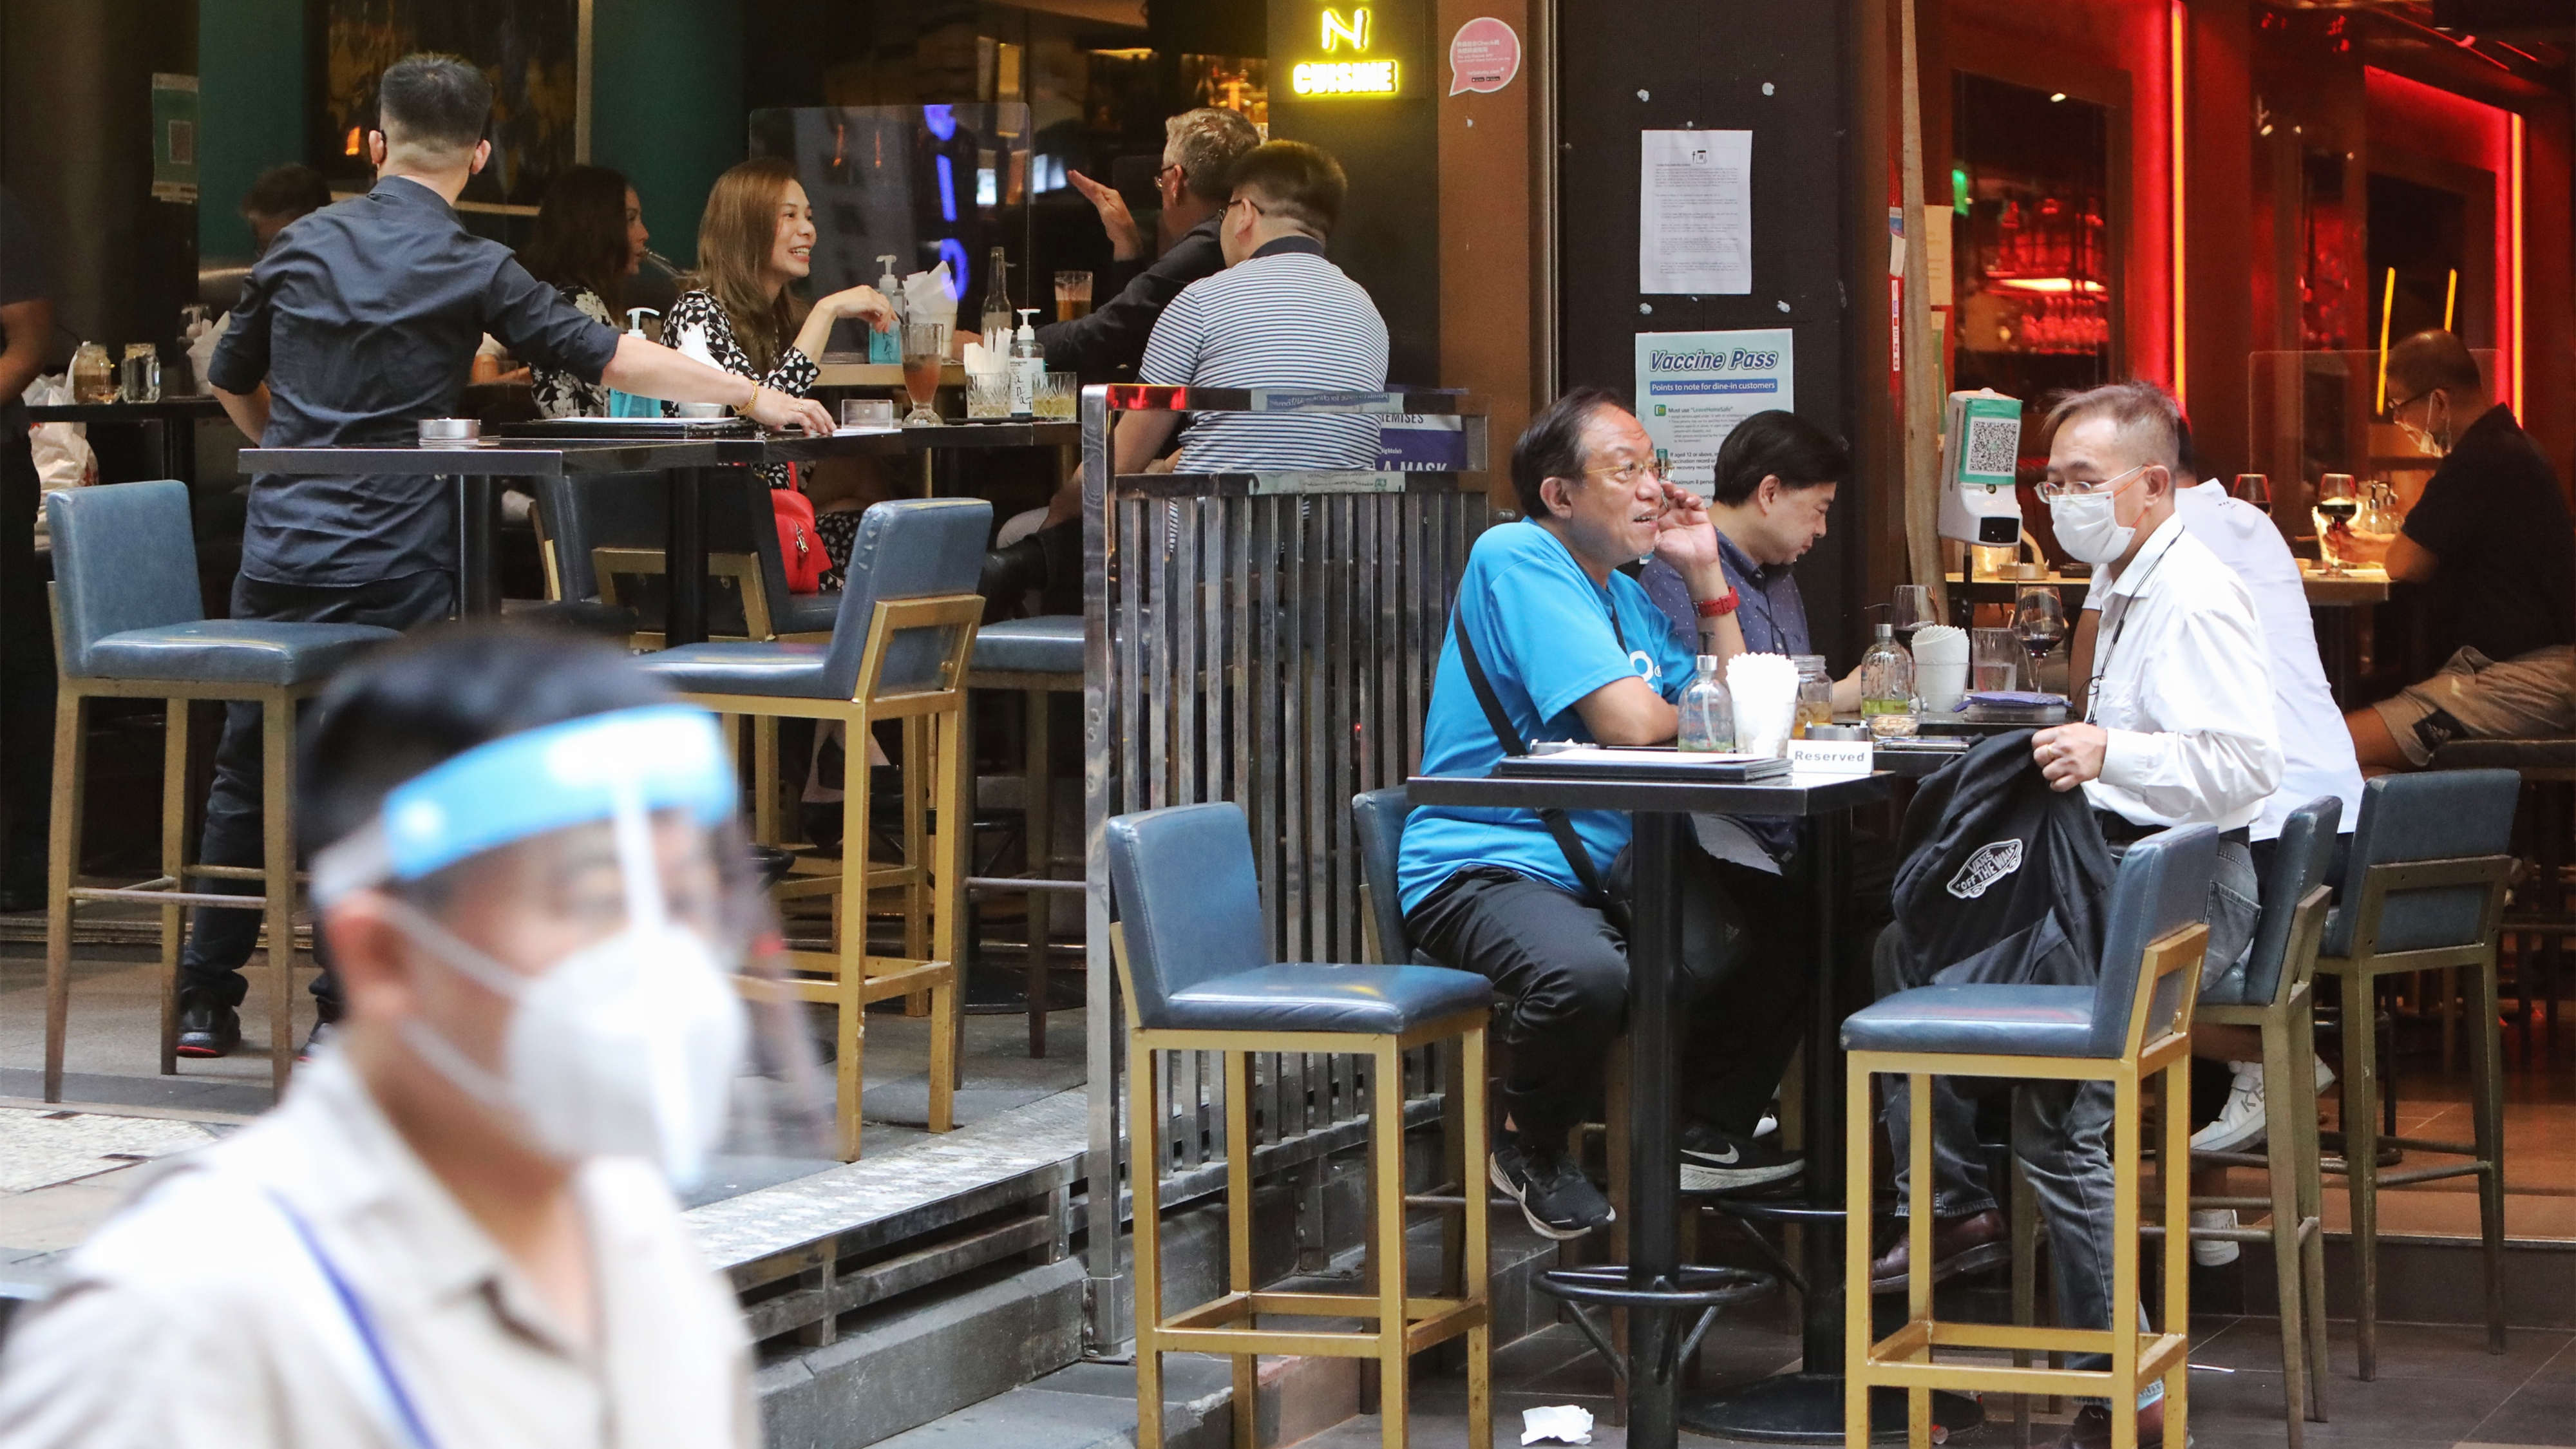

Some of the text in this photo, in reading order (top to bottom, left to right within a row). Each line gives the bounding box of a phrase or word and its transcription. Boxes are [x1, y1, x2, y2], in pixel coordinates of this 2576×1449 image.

[1322, 8, 1370, 52] N
[1293, 60, 1397, 96] CUISINE
[1650, 348, 1778, 372] Vaccine Pass
[1712, 382, 1738, 390] dine-in
[1381, 414, 1424, 423] EMISES
[1794, 750, 1865, 762] Reserved
[1967, 849, 1994, 874] VANS
[1975, 862, 1998, 882] THE
